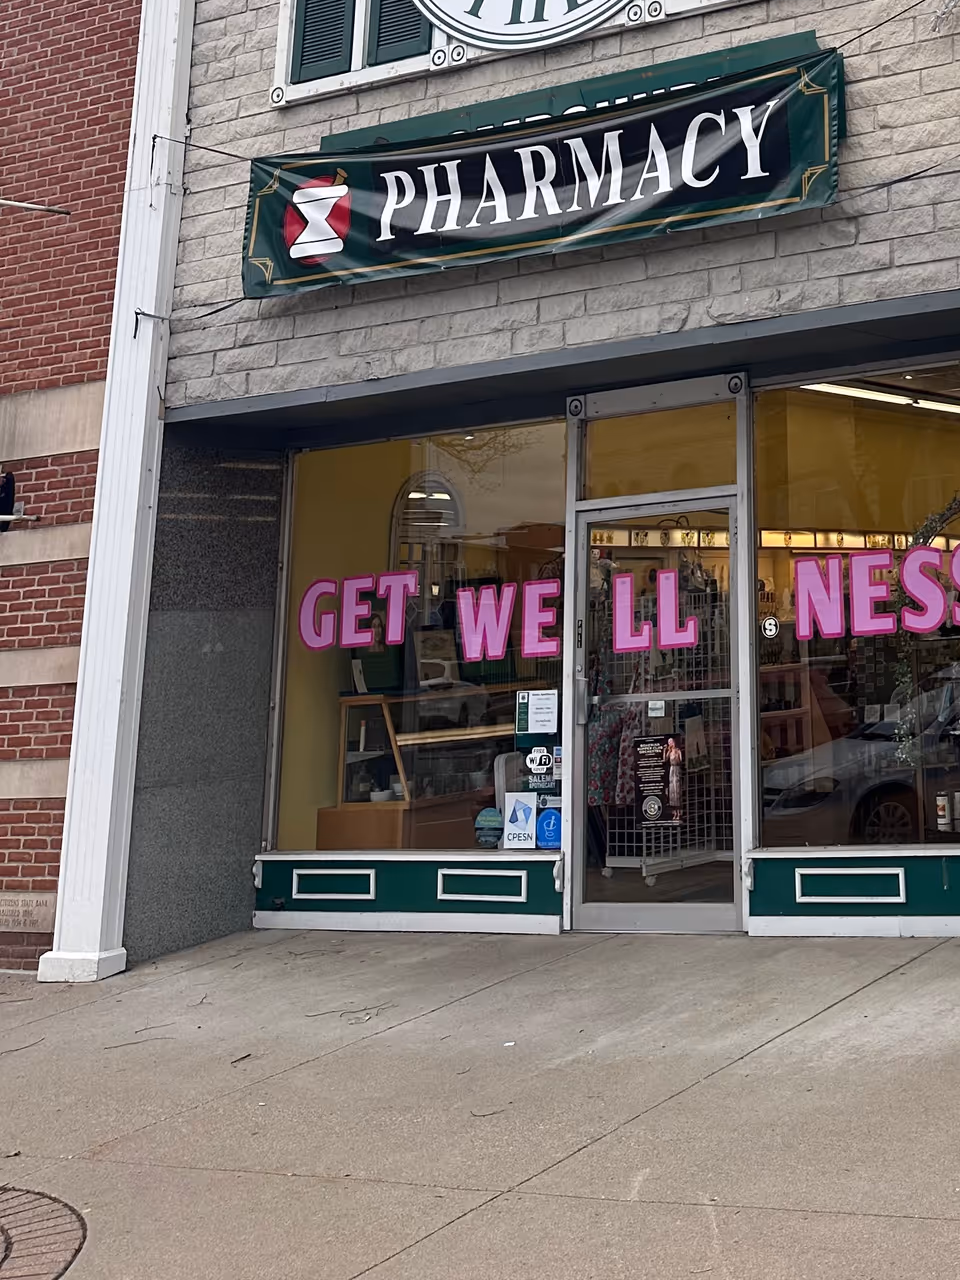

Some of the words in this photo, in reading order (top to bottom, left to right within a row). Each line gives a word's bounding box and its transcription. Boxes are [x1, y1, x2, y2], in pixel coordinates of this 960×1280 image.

[376, 99, 779, 242] PHARMACY
[299, 570, 419, 650] GET
[507, 832, 534, 842] CPESN
